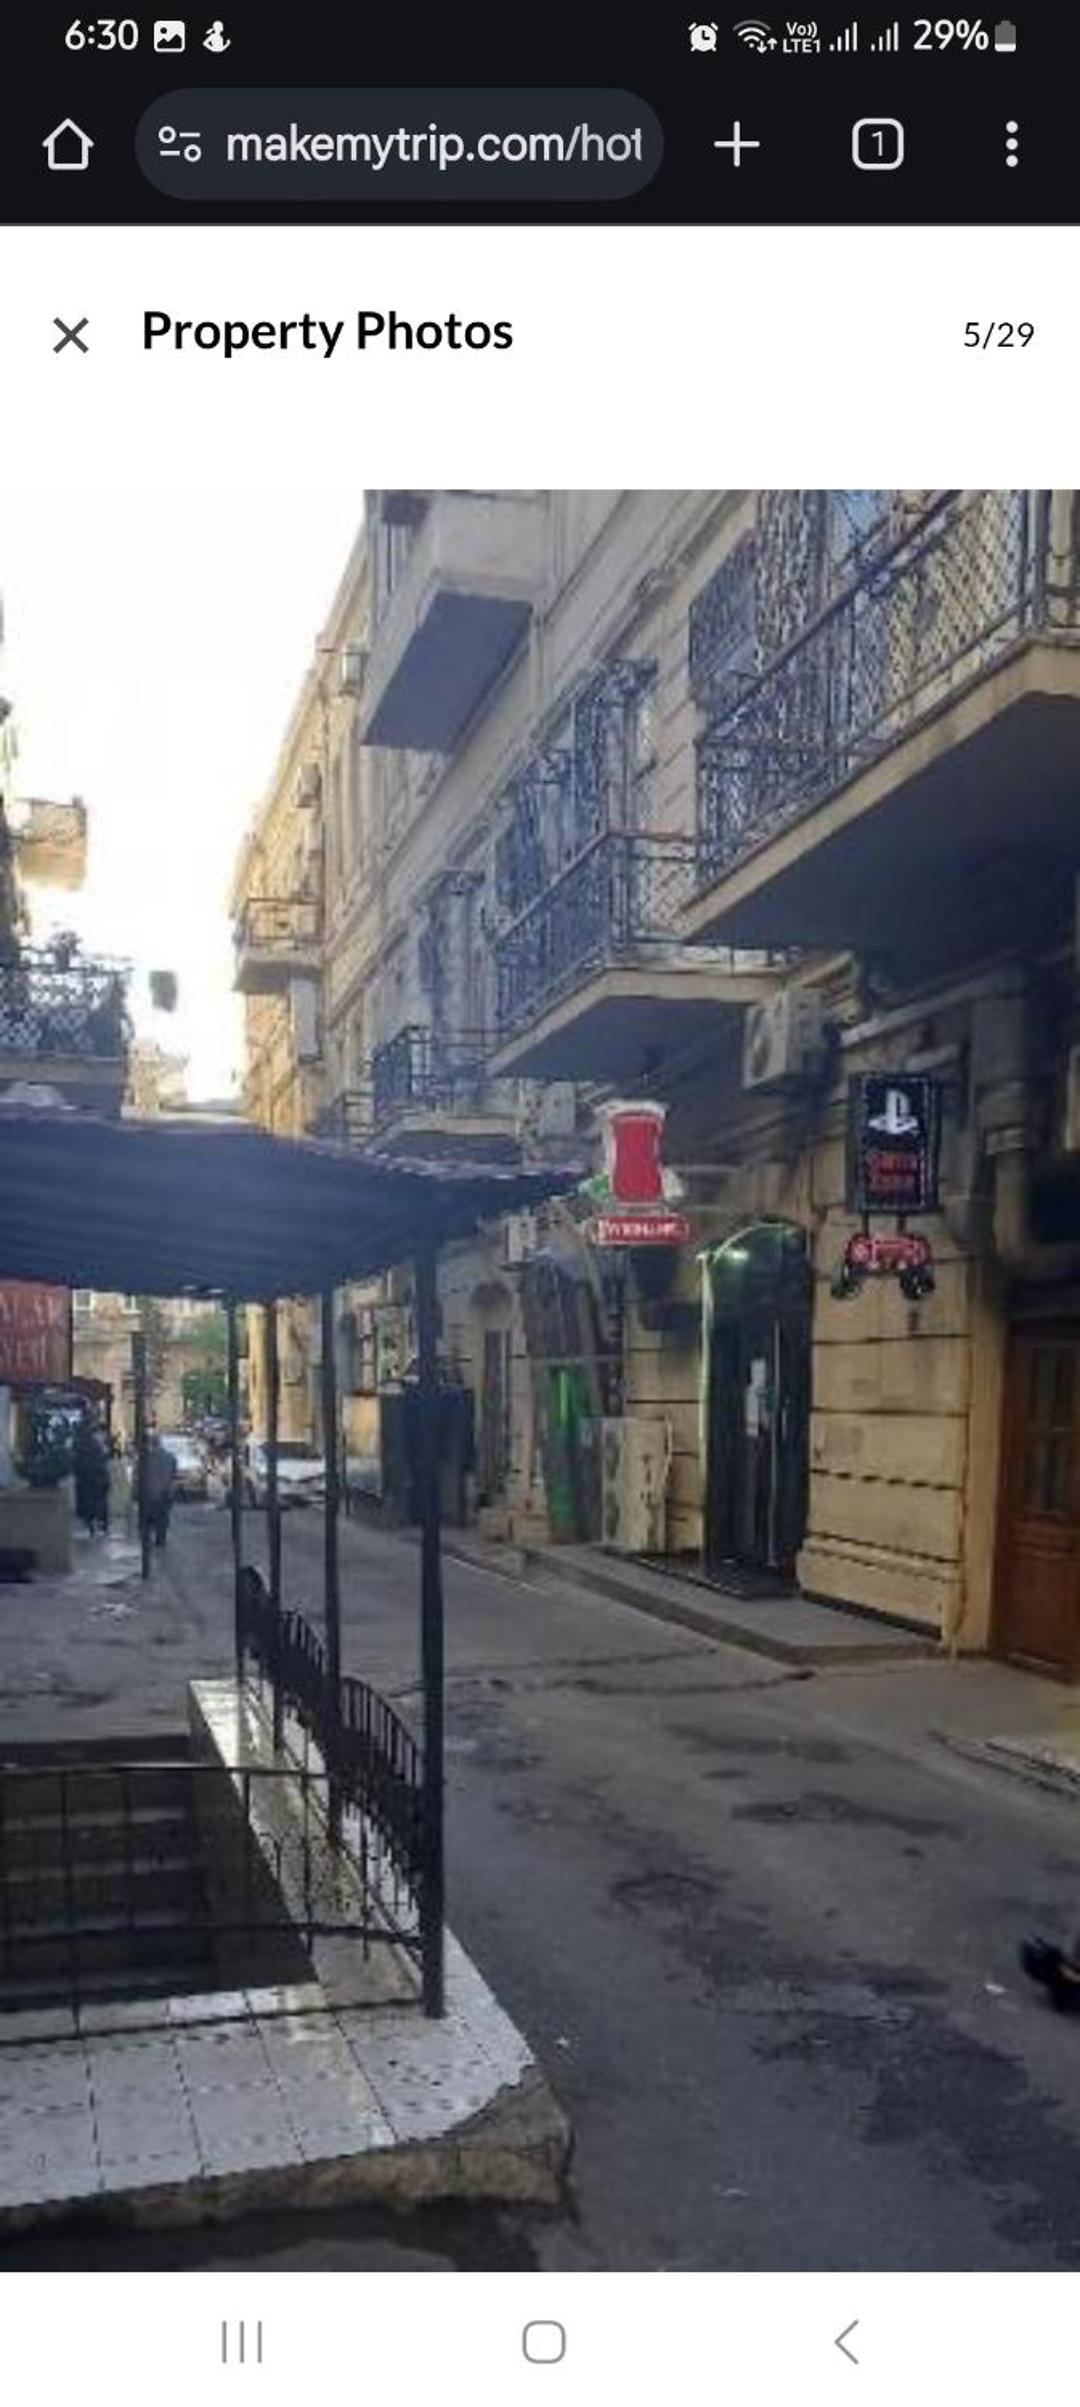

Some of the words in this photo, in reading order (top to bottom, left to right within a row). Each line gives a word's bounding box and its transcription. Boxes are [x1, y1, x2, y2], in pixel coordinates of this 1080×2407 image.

[65, 18, 139, 51] 6:30
[782, 37, 821, 53] LTE1
[913, 18, 990, 51] 29%
[227, 122, 642, 171] makemytrip.com/hot
[871, 131, 884, 157] 1
[143, 310, 345, 359] Property
[357, 310, 514, 350] Photos
[963, 321, 1035, 352] 5/29
